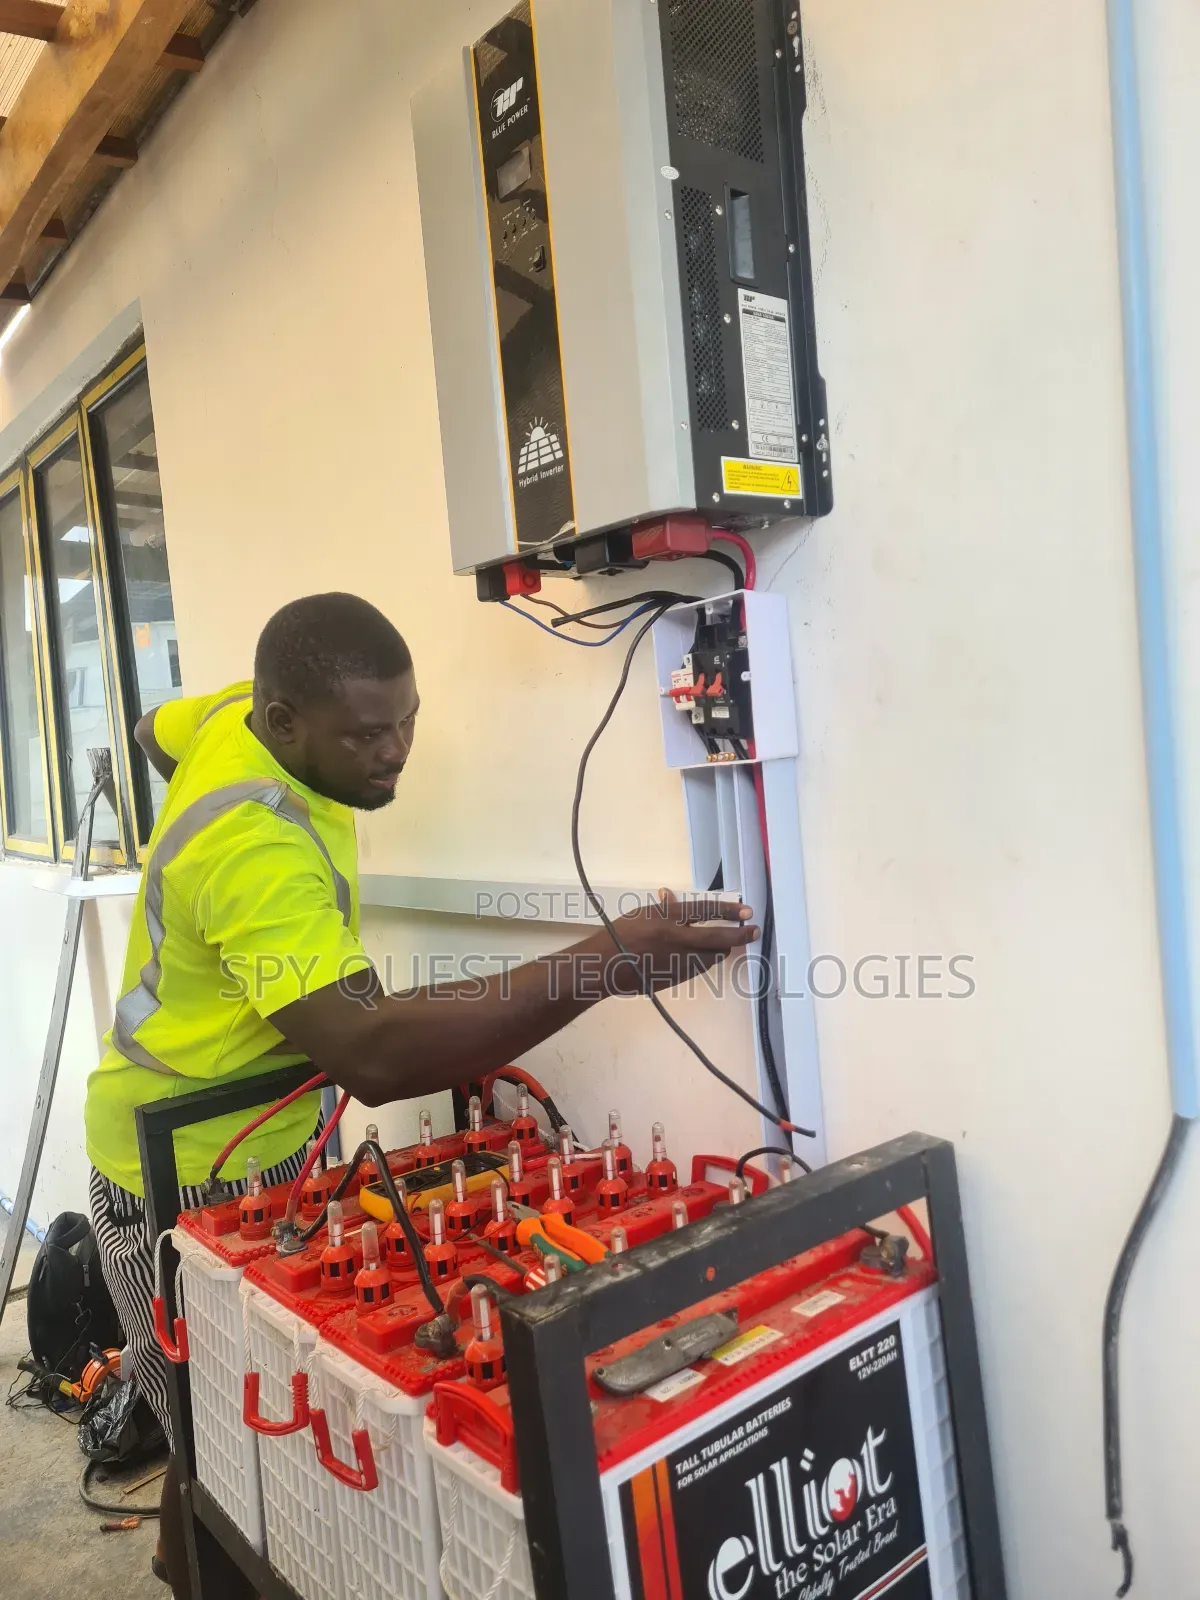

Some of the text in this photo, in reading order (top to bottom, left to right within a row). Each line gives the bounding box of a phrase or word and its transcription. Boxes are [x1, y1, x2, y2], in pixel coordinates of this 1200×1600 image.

[492, 104, 528, 139] BLUE POWER
[519, 464, 564, 487] Hybrid Inverter
[849, 1334, 896, 1371] ELTT 220
[857, 1349, 897, 1380] 12V-220AH
[675, 1397, 792, 1475] TALL TUBULAR BATTERIES
[677, 1427, 769, 1490] FOR SOLAR APPLICATIONS
[708, 1425, 893, 1600] elliot
[774, 1496, 898, 1599] the Solar Era
[838, 1540, 872, 1581] Trusted
[873, 1520, 899, 1554] Brand
